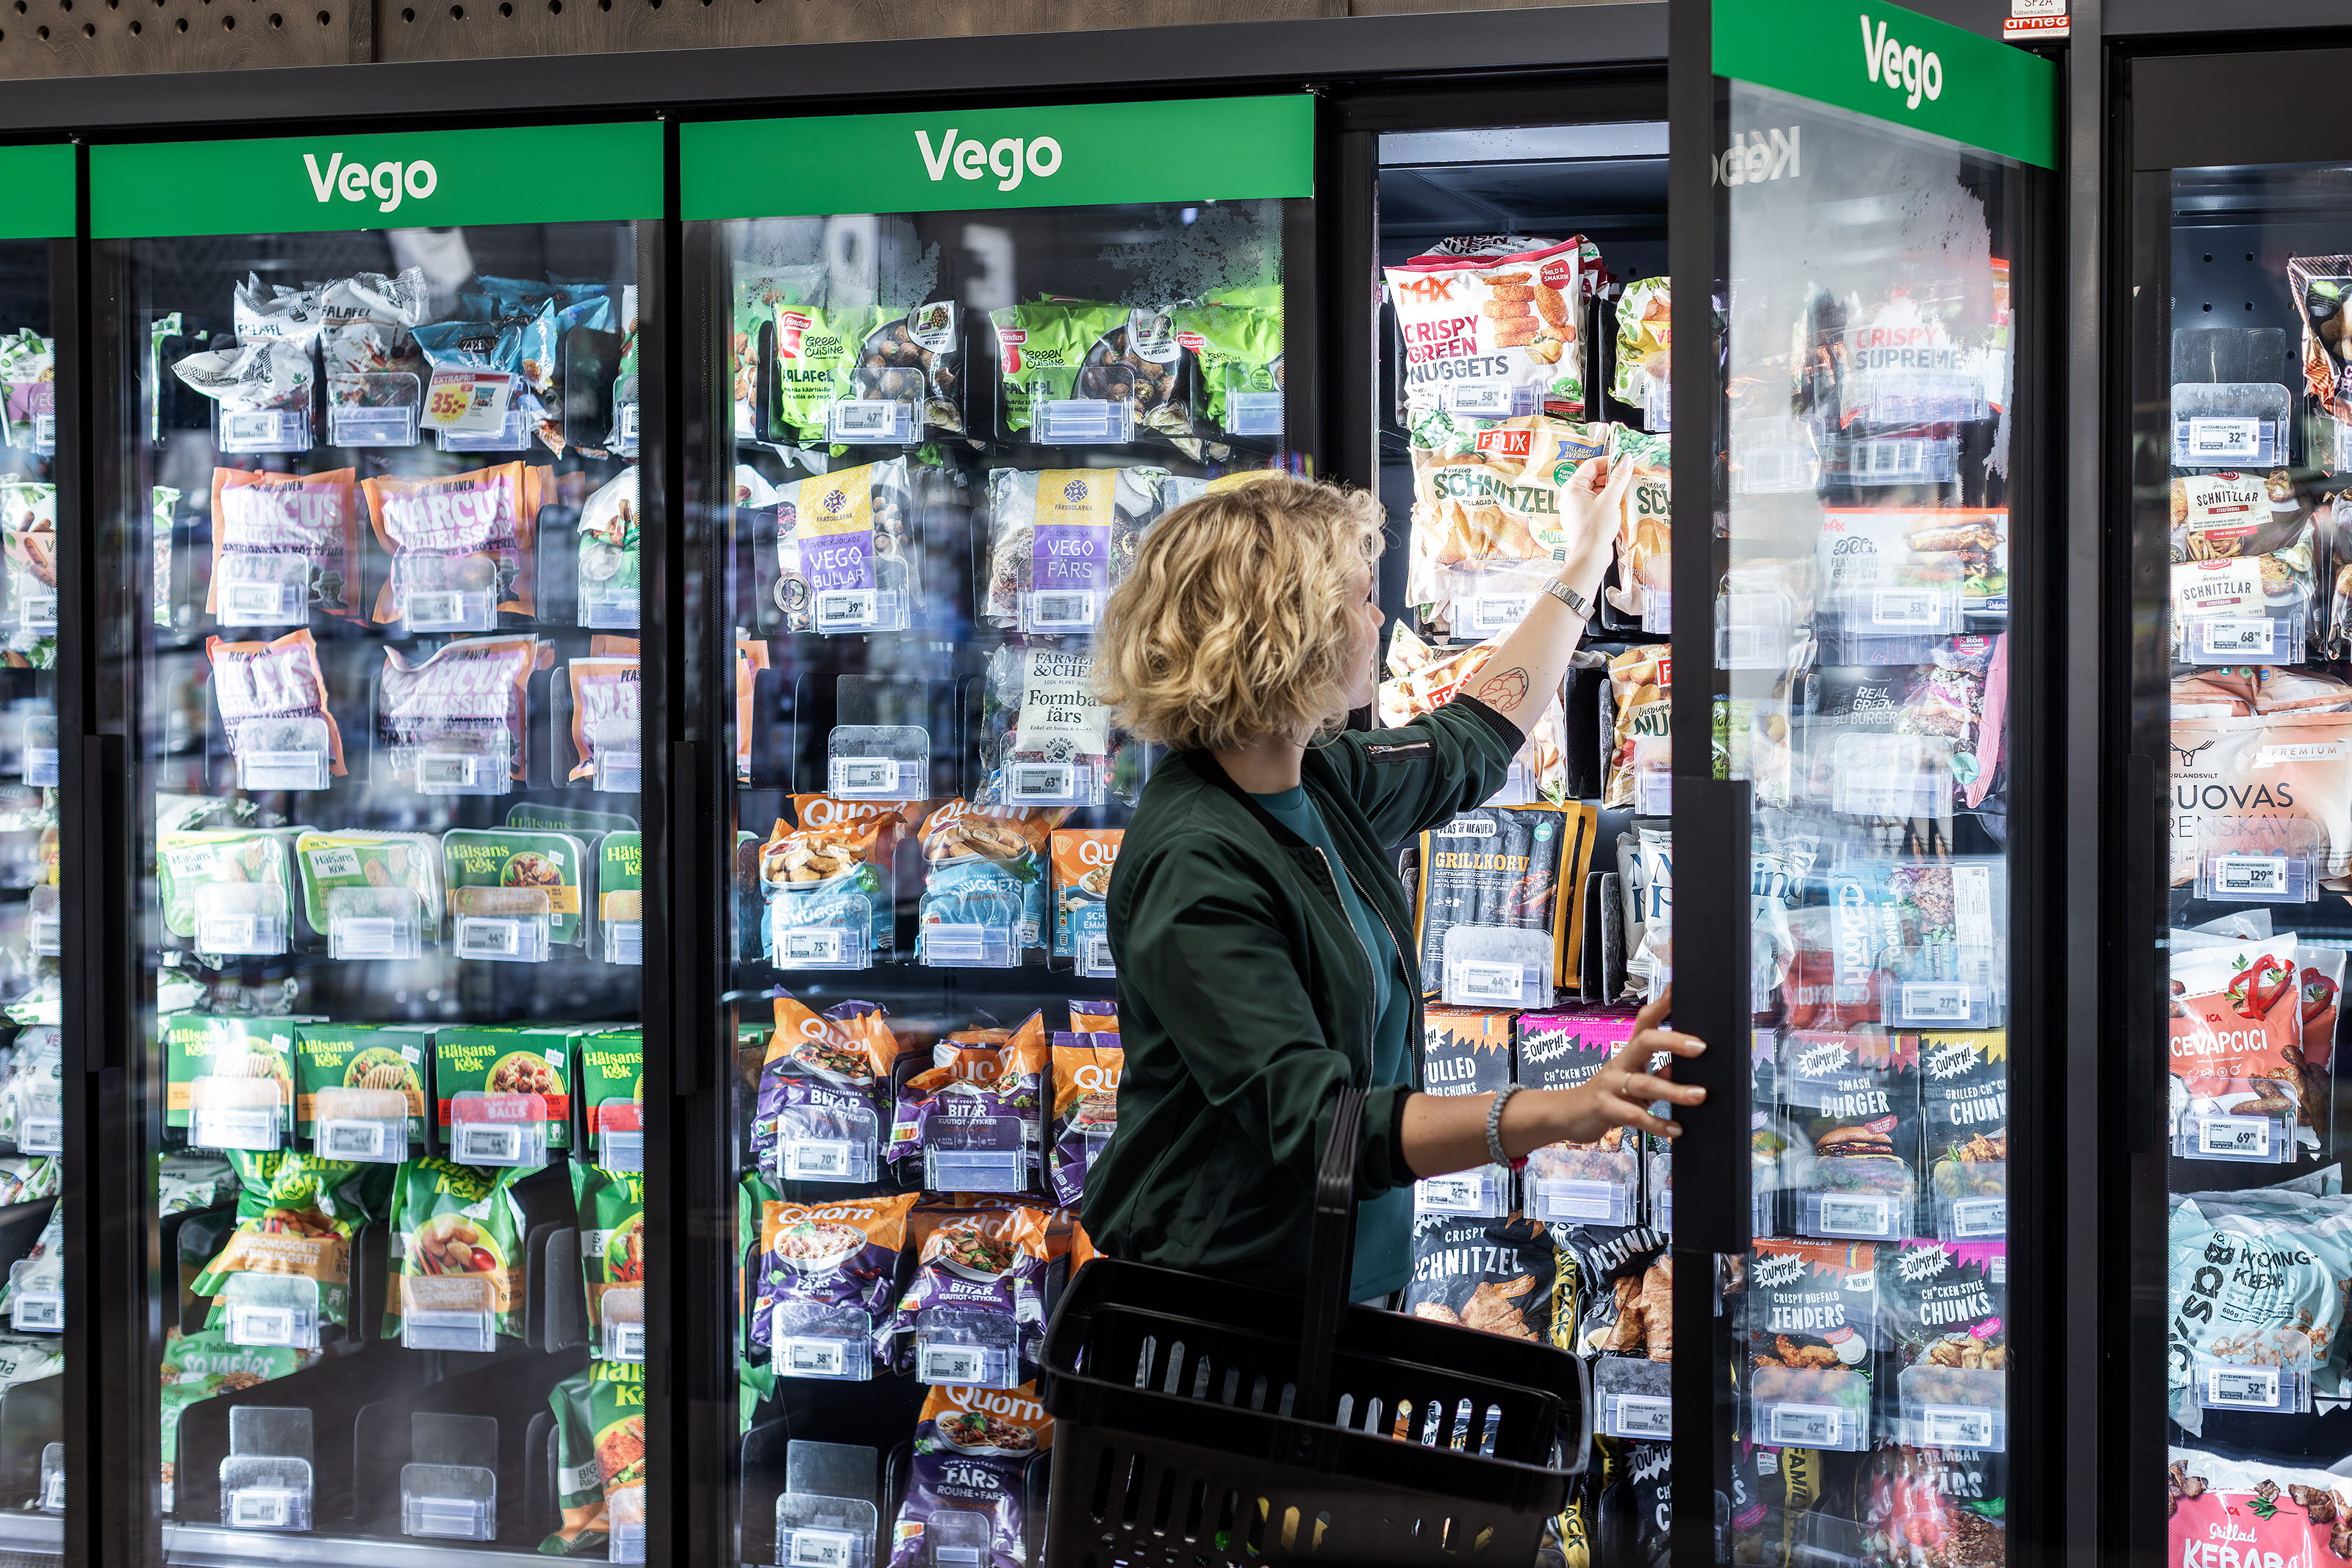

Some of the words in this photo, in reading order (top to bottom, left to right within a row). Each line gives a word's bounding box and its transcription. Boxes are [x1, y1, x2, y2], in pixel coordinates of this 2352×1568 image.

[1860, 14, 1943, 110] Vego
[914, 129, 1062, 192] Vego
[304, 151, 438, 212] Vego
[1544, 268, 1558, 276] MILD
[1544, 274, 1569, 282] SMAKRIK
[320, 305, 370, 317] FALAFEL
[784, 316, 811, 329] Findus
[1404, 314, 1479, 344] CRISPY
[805, 334, 842, 346] GREEN
[1001, 332, 1024, 342] Findus
[1179, 337, 1204, 347] Findus
[1856, 327, 1940, 349] CRISPY
[1023, 348, 1062, 360] GREEN
[1408, 337, 1477, 364] GREEN
[1855, 348, 1964, 371] SUPREME
[433, 373, 476, 384] EXTRAPRIS
[1410, 355, 1509, 386] NUGGETS
[430, 392, 466, 414] 35:-
[1481, 431, 1526, 451] FELIX
[1566, 445, 1591, 455] TILLAGAT
[1433, 472, 1562, 514] SCHNITZEL
[2197, 492, 2258, 506] SCHNITZLAR
[817, 513, 853, 522] FÄRSODLARNA
[808, 536, 861, 549] SVENSKODLADE
[1047, 540, 1094, 555] VEGO
[808, 546, 863, 571] VEGO
[1048, 559, 1092, 578] FÄRS
[813, 569, 865, 588] BULLAR
[2202, 574, 2231, 582] Svenska
[2184, 582, 2251, 600] SCHNITZLAR
[1857, 686, 1888, 698] REAL
[1853, 699, 1895, 711] GREEN
[1046, 707, 1082, 724] färs
[1850, 711, 1899, 724] BURGER
[1046, 738, 1057, 749] EAT
[2271, 746, 2337, 756] PREMIUM
[1466, 823, 1494, 833] HEAVEN
[315, 849, 354, 864] Hälsans
[445, 844, 510, 860] Hälsans
[185, 862, 202, 874] Kök
[329, 863, 347, 875] Kök
[1435, 852, 1530, 871] GRILLKORV
[2206, 1013, 2223, 1023] ICA
[298, 1039, 354, 1055] Hälsans
[1530, 1035, 1563, 1058] OUMPH!
[2171, 1029, 2267, 1057] CEVAPCICI
[438, 1043, 496, 1060] Hälsans
[584, 1051, 642, 1067] Hälsans
[1807, 1047, 1841, 1071] OUMPH!
[1936, 1047, 1971, 1072] OUMPH!
[1838, 1076, 1871, 1092] SMASH
[810, 1088, 861, 1111] BITAR
[1946, 1087, 1979, 1100] GRILLED
[948, 1104, 987, 1117] BITAR
[1821, 1090, 1891, 1118] BURGER
[488, 1107, 526, 1118] BALLS
[938, 1118, 967, 1126] KUUTIOT
[778, 1206, 875, 1225] Quorn
[1444, 1227, 1487, 1243] CRISPY
[1762, 1259, 1798, 1280] OUMPH!
[1906, 1249, 1942, 1274] OUMPH!
[950, 1281, 994, 1295] BITAR
[1851, 1276, 1871, 1287] NEW!
[1961, 1279, 1985, 1294] STYLE
[939, 1292, 968, 1302] KUUTIOT
[972, 1293, 1003, 1303] STYKKER
[1774, 1292, 1802, 1304] CRISPY
[1805, 1290, 1840, 1303] BUFFALO
[1772, 1303, 1845, 1330] TENDERS
[1919, 1292, 1992, 1326] CHUNKS
[945, 1384, 1044, 1422] Quorn
[944, 1462, 1000, 1489] FÄRS
[936, 1485, 974, 1498] ROUHE
[980, 1489, 1005, 1502] FARS
[2209, 1522, 2257, 1544] Grillad
[2183, 1538, 2284, 1568] KEBAB
